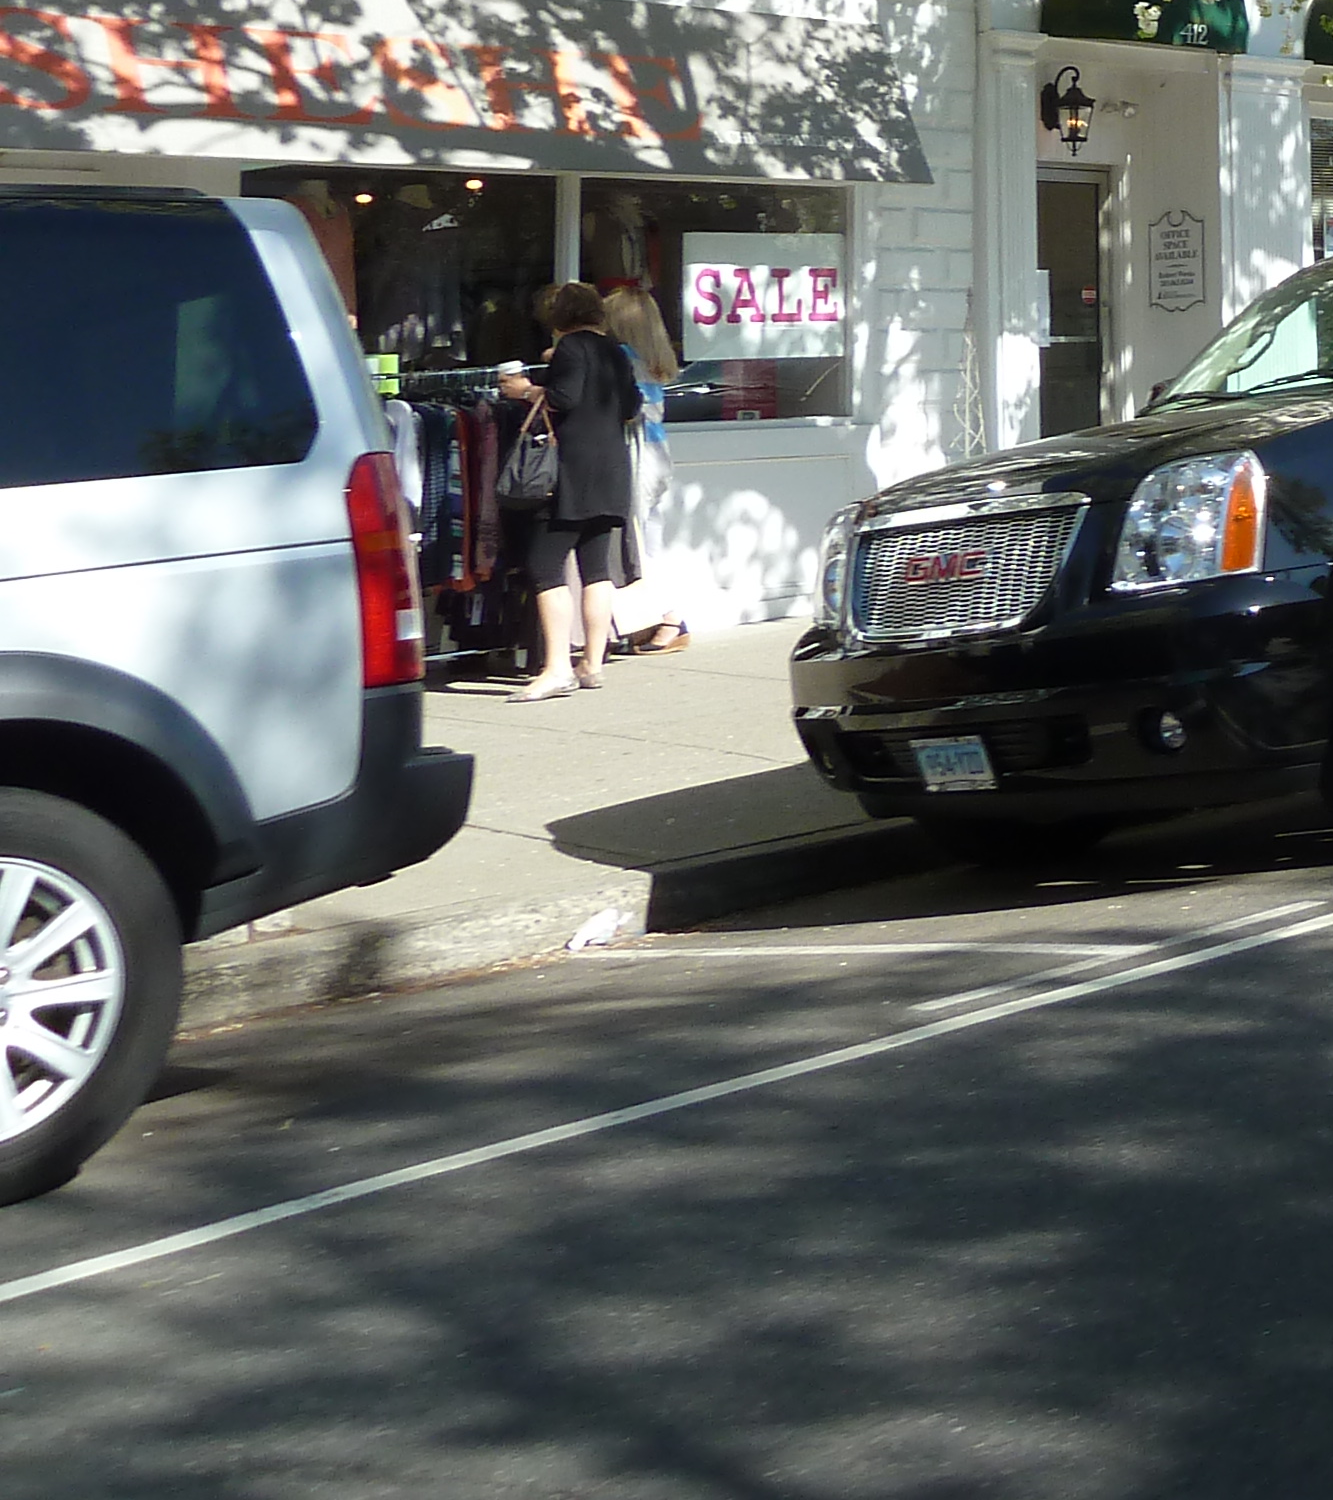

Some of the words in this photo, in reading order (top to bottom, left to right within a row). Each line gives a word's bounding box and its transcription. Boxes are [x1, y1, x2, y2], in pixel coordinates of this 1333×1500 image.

[1180, 23, 1209, 45] 412
[693, 267, 840, 326] SALE
[905, 549, 986, 583] GMC
